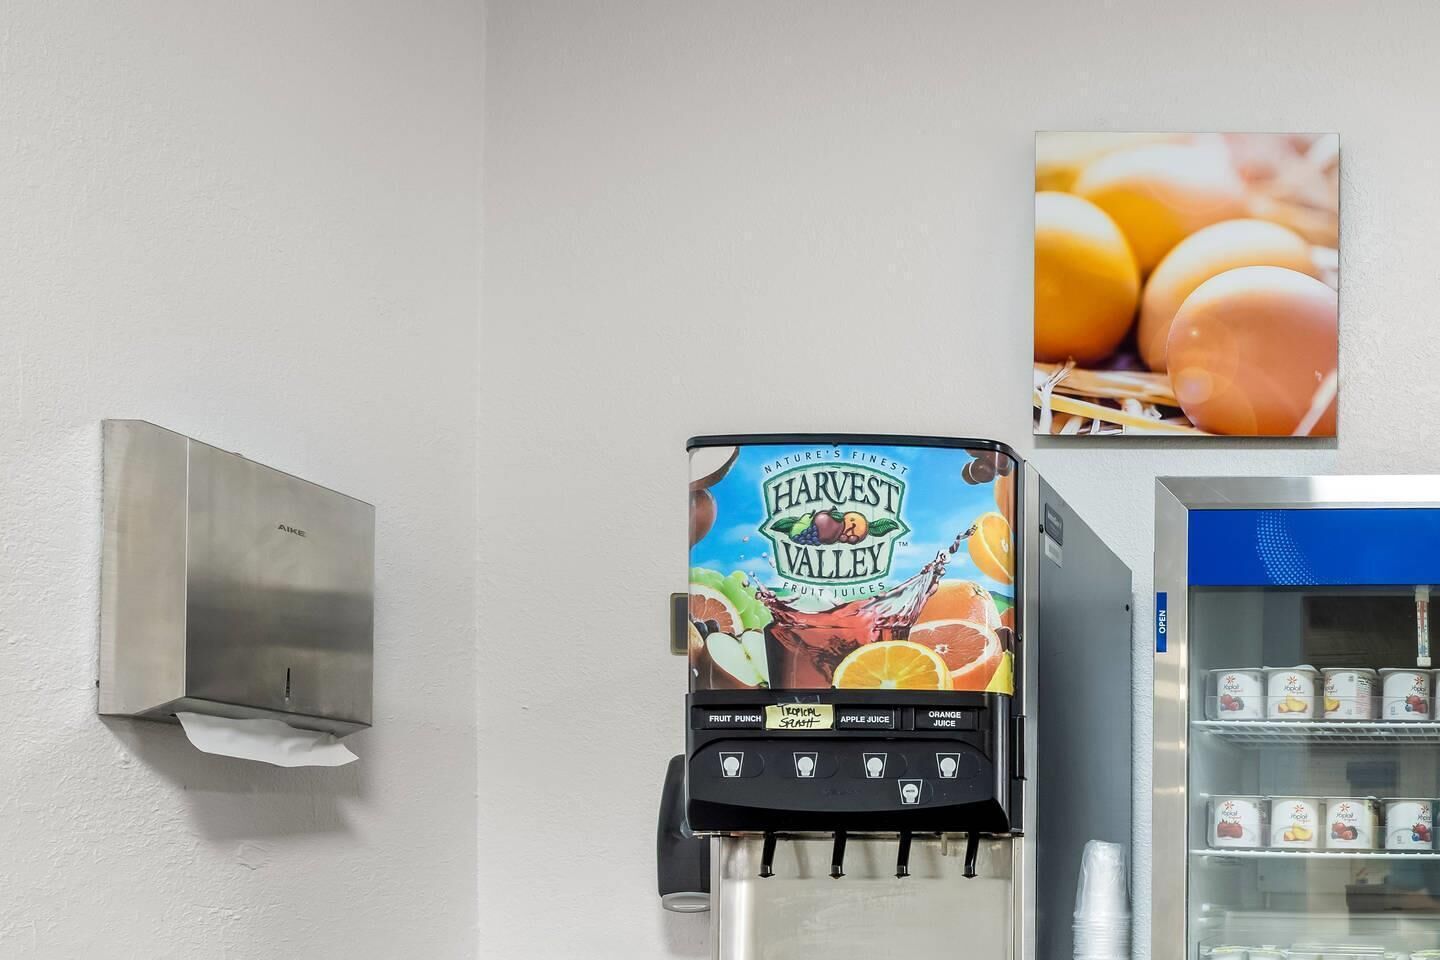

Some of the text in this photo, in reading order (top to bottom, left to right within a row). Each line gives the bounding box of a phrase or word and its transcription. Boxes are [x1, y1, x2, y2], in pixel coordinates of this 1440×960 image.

[764, 450, 908, 475] NATURE'S FINEST
[772, 470, 901, 516] HARVEST
[781, 541, 886, 579] VALLEY
[782, 581, 886, 598] FRUIT JUICES
[1158, 609, 1167, 634] OPEN
[777, 703, 822, 717] TROPICAL
[928, 710, 962, 719] ORANGE
[735, 715, 762, 723] PUNCH
[933, 719, 956, 727] JUICE
